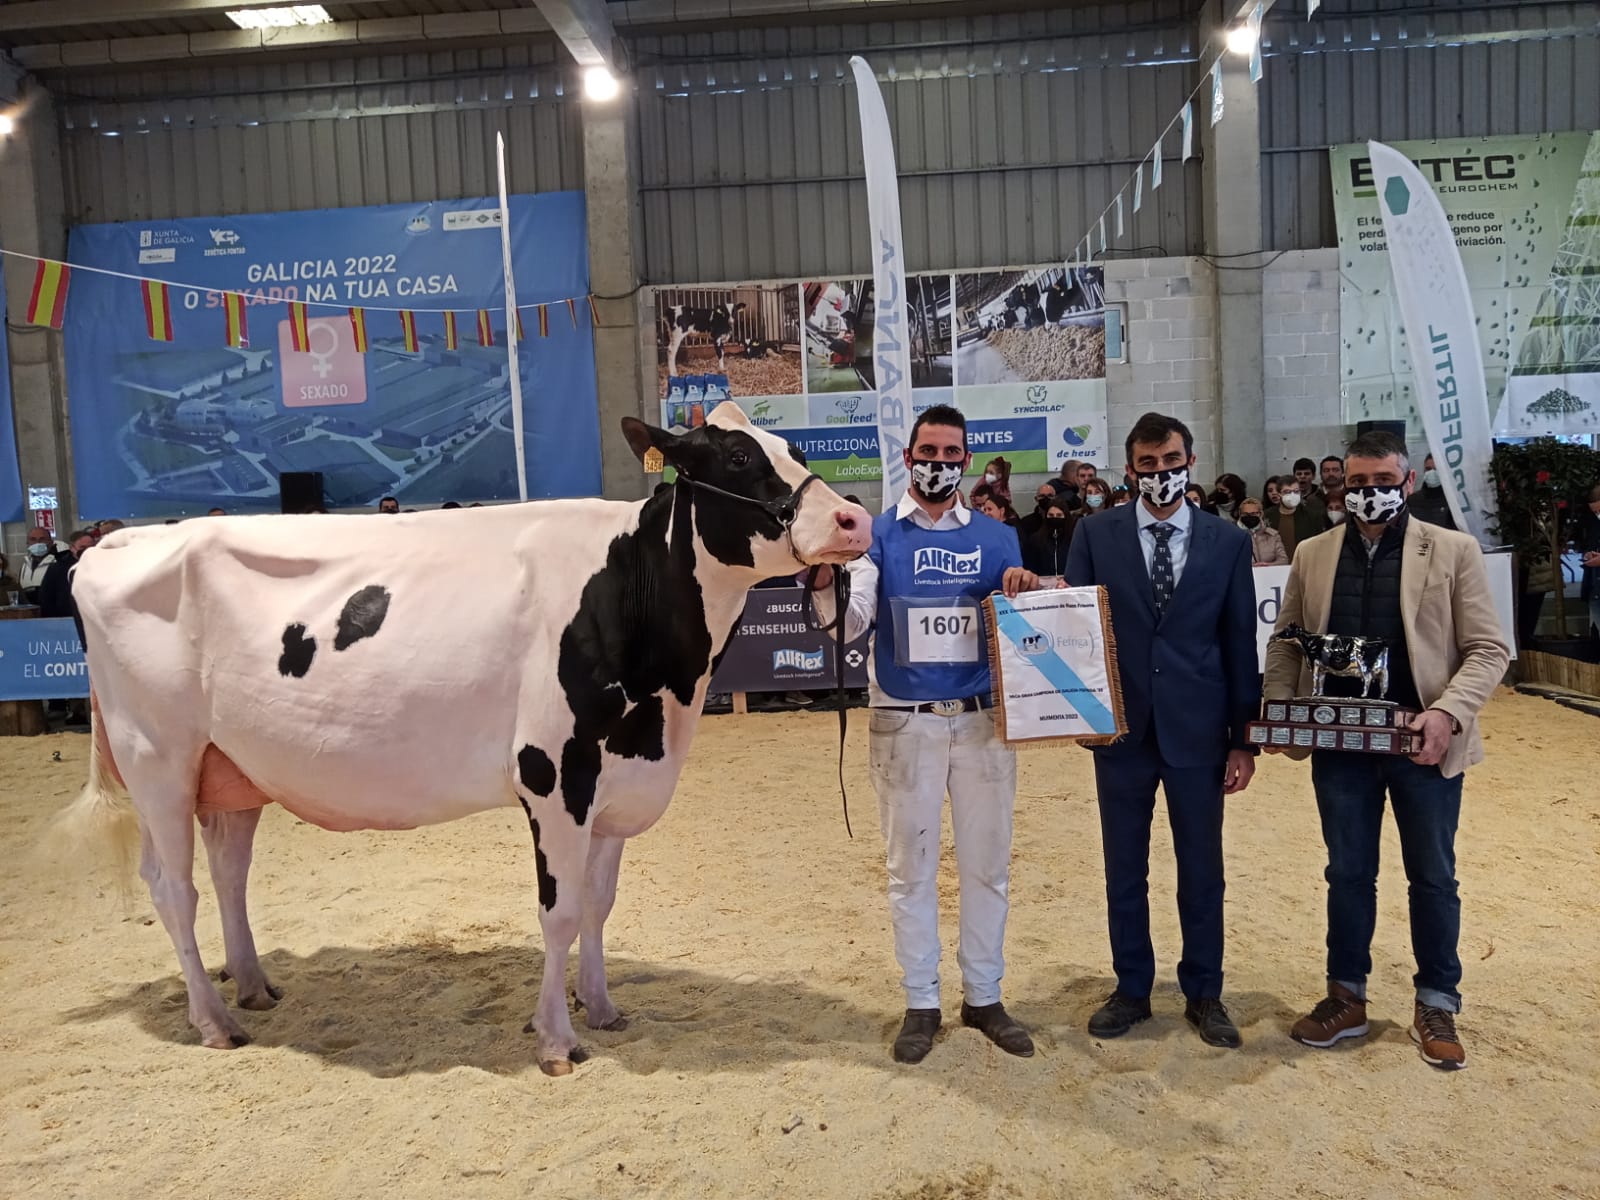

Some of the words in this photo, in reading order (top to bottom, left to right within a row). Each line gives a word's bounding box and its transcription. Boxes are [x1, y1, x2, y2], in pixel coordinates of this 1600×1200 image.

[1349, 154, 1516, 187] ETEC
[1439, 183, 1519, 193] EUROCHEM
[1356, 216, 1369, 226] El
[1456, 210, 1496, 221] reduce
[153, 229, 180, 237] XUNTA
[164, 236, 195, 244] GALICIA
[1358, 228, 1386, 241] perd
[1450, 225, 1481, 237] geno
[1483, 223, 1504, 235] por
[247, 259, 338, 283] GALICIA
[344, 254, 397, 276] 2022
[184, 290, 199, 310] O
[306, 283, 337, 302] NA
[344, 278, 390, 300] TUA
[396, 274, 458, 296] CASA
[300, 383, 348, 400] SEXADO
[1013, 404, 1062, 414] SYNCROLAC
[749, 416, 777, 426] aliber
[826, 413, 873, 424] Goalfeed
[796, 437, 879, 453] UTRICIONA
[966, 430, 1014, 445] ENTES
[1056, 450, 1070, 458] de
[1071, 449, 1097, 458] heus
[916, 550, 979, 574] Allflex
[741, 623, 807, 636] SENSEHUB
[919, 615, 971, 635] 1607
[28, 640, 50, 656] UN
[774, 649, 822, 670] Allflex
[24, 663, 41, 678] EL
[44, 662, 88, 677] CONT
